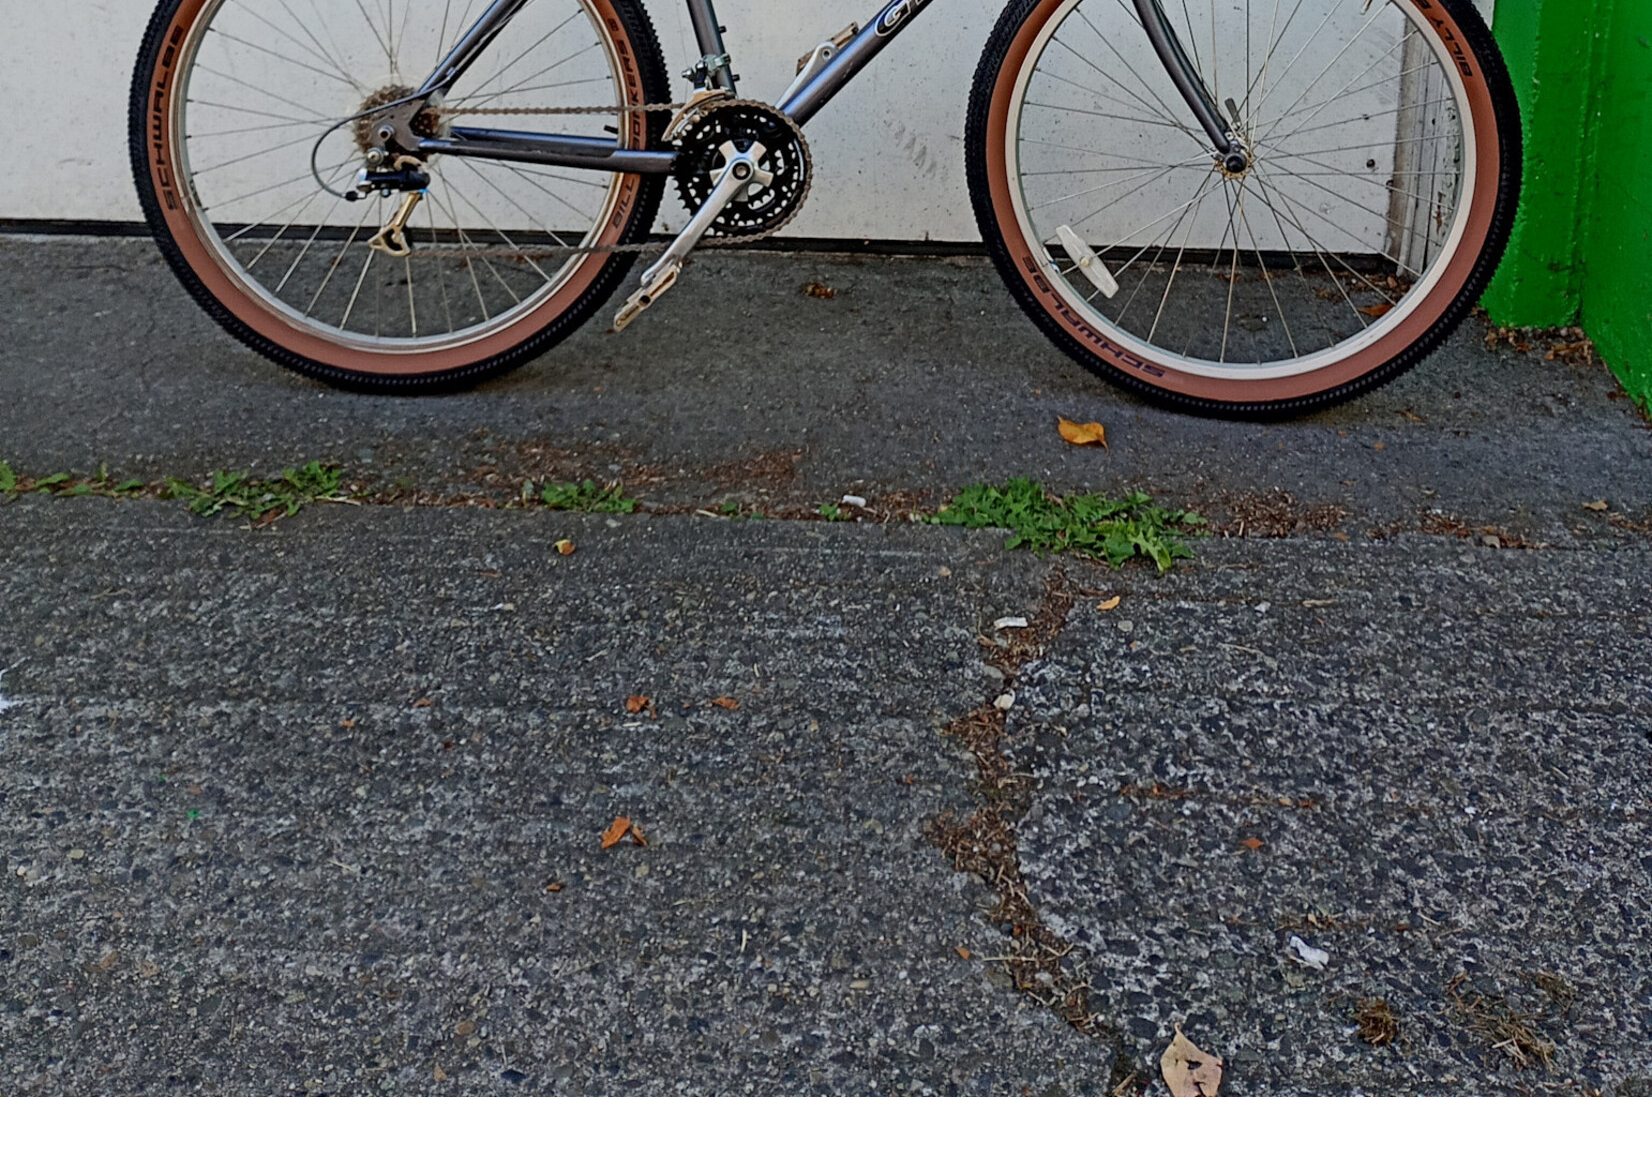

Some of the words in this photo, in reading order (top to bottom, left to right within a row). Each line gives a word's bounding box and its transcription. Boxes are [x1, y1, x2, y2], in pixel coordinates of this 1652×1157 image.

[1429, 16, 1474, 78] BILLY
[152, 24, 184, 211] SCHWALBE
[1022, 256, 1166, 378] SCHWALBE
